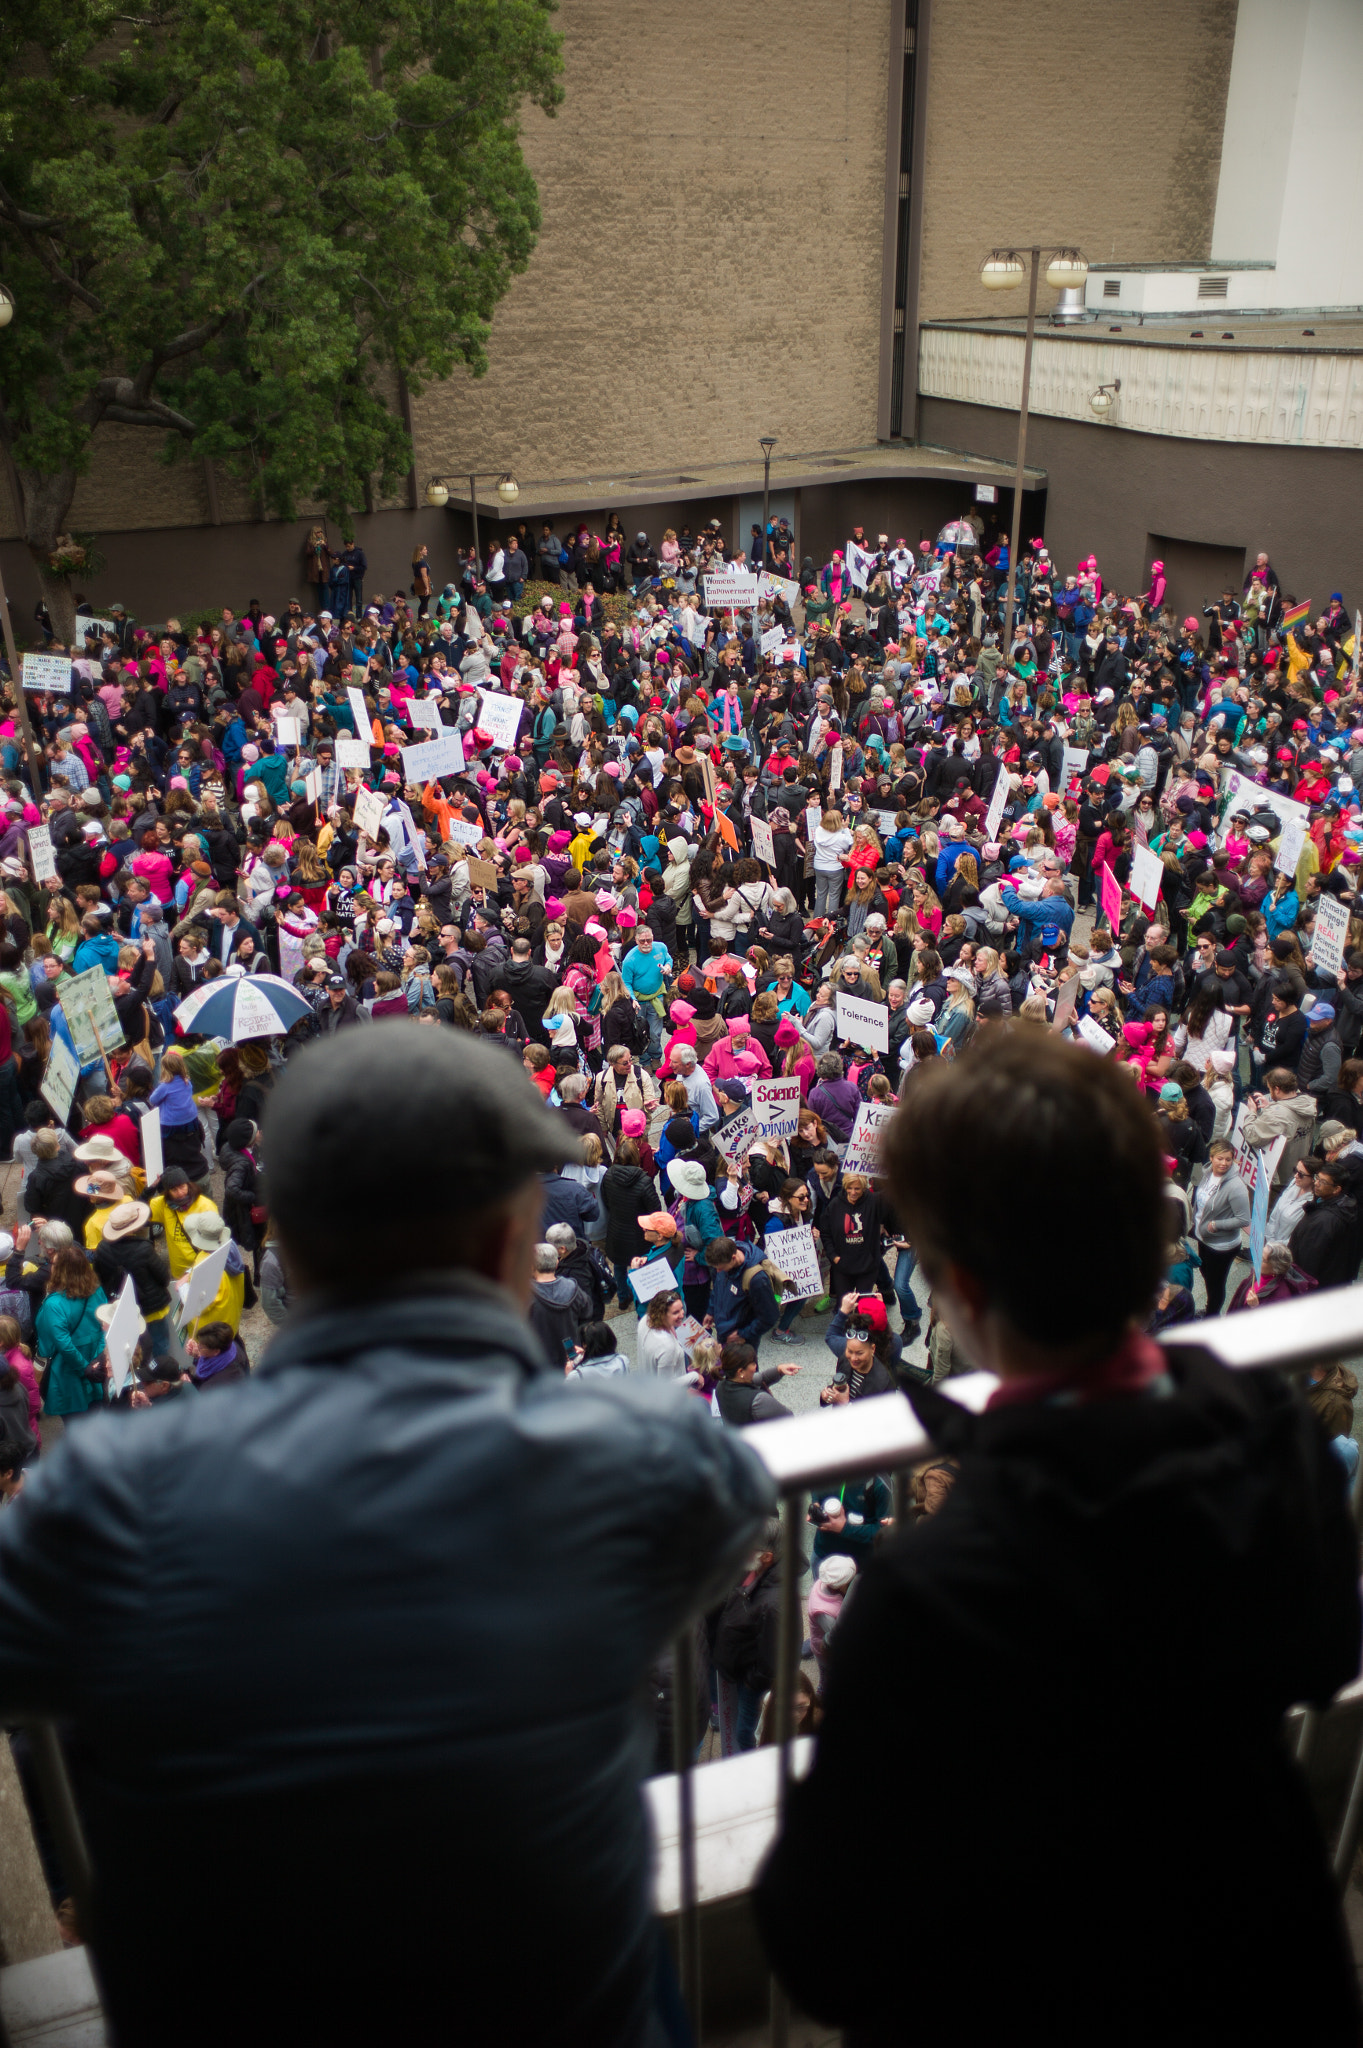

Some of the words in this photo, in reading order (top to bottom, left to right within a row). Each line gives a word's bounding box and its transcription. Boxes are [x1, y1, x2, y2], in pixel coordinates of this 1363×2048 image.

[705, 576, 736, 585] Women's
[707, 597, 751, 605] International
[1319, 905, 1346, 928] Change
[1320, 896, 1348, 919] Climate
[1317, 923, 1339, 943] REAL!
[1327, 919, 1334, 930] Is
[1313, 942, 1329, 957] Can't
[1329, 952, 1339, 963] Be
[1315, 933, 1340, 954] Science
[841, 1007, 884, 1028] Tolerance
[756, 1084, 800, 1103] Science
[721, 1115, 749, 1142] Make
[843, 1158, 860, 1172] MY
[766, 1235, 777, 1247] A
[791, 1254, 809, 1266] THE
[785, 1266, 813, 1280] OUSE
